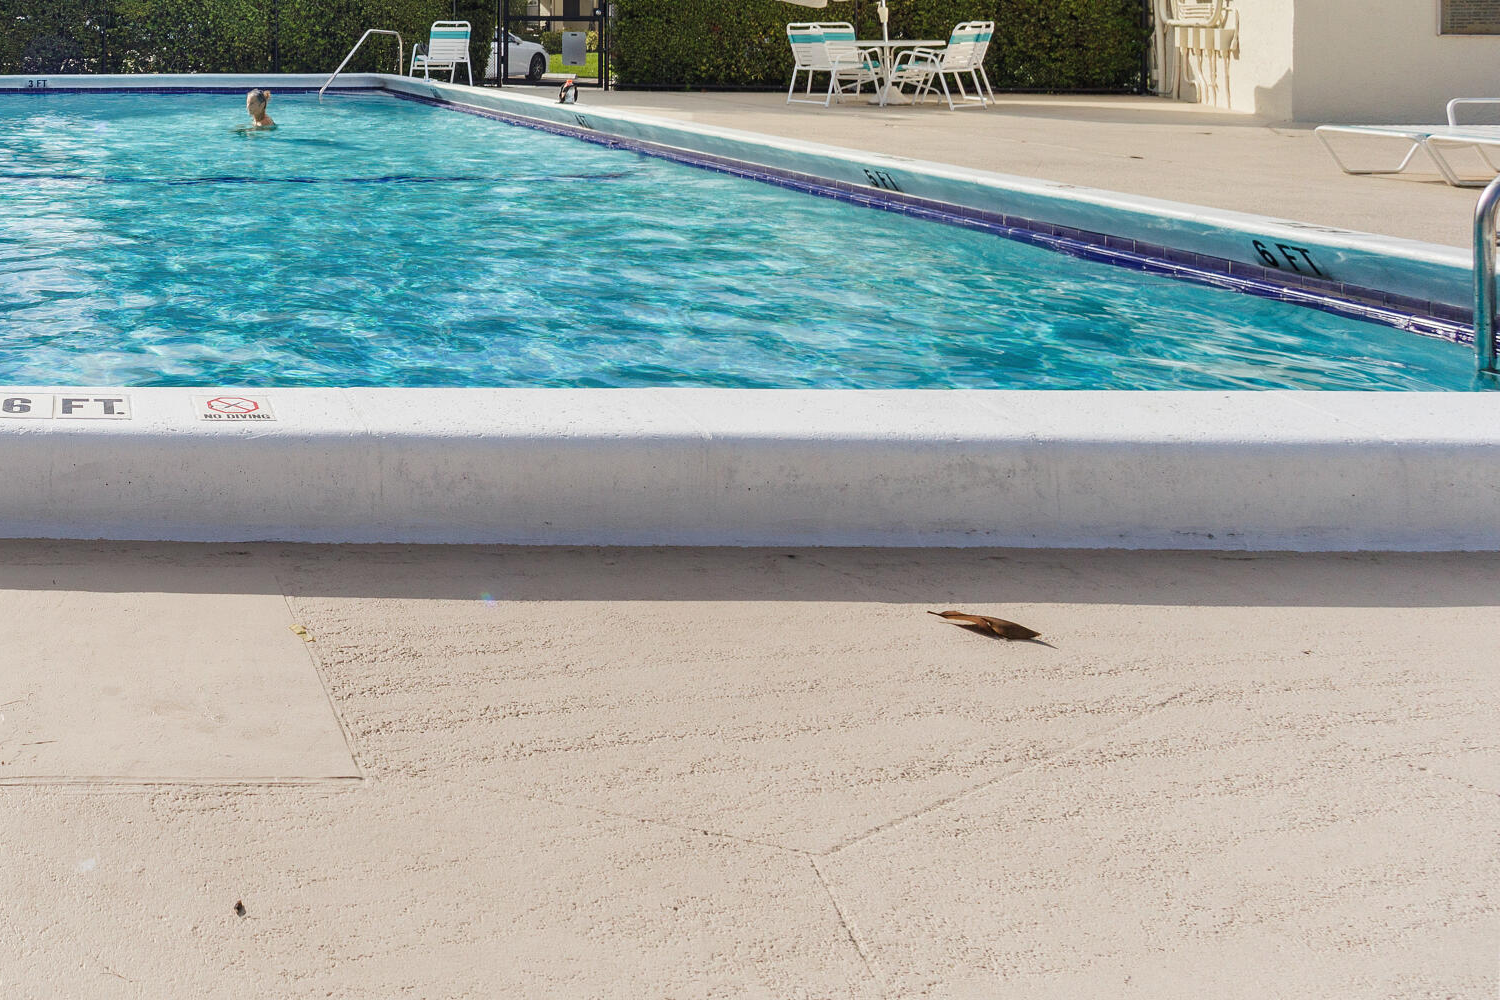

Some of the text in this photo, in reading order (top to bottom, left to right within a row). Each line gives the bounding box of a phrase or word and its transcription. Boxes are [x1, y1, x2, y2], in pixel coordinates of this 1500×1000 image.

[28, 79, 48, 88] 3 FT
[1251, 239, 1323, 276] 6 FT
[1, 397, 32, 414] 6
